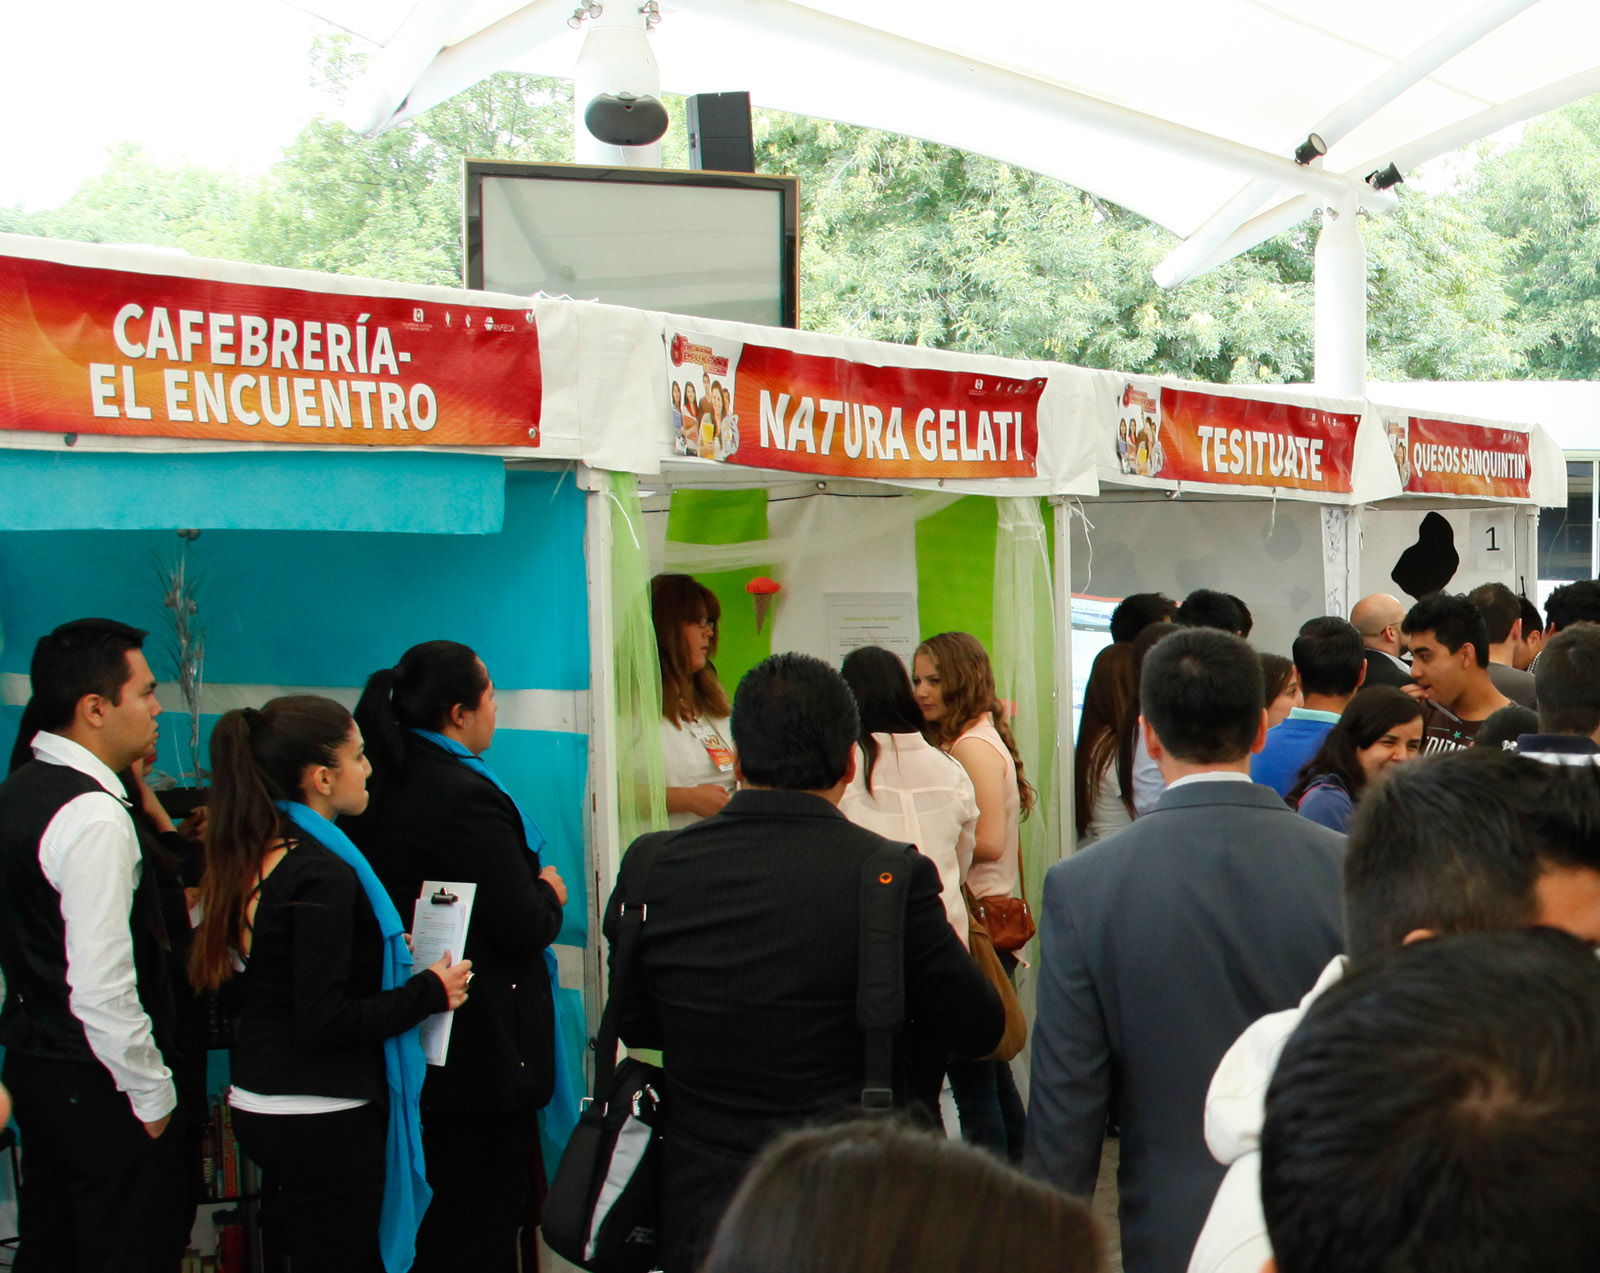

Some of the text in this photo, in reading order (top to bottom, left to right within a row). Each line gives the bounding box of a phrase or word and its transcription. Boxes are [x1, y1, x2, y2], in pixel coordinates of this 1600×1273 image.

[112, 302, 412, 375] CAFEBRERÍA-
[90, 362, 438, 432] EL ENCUENTRO
[759, 389, 1024, 462] NATURA GELATI
[1197, 425, 1324, 482] TESITUATE
[1413, 442, 1527, 483] QUESOS SANQUINTIN
[1485, 526, 1501, 551] 1
